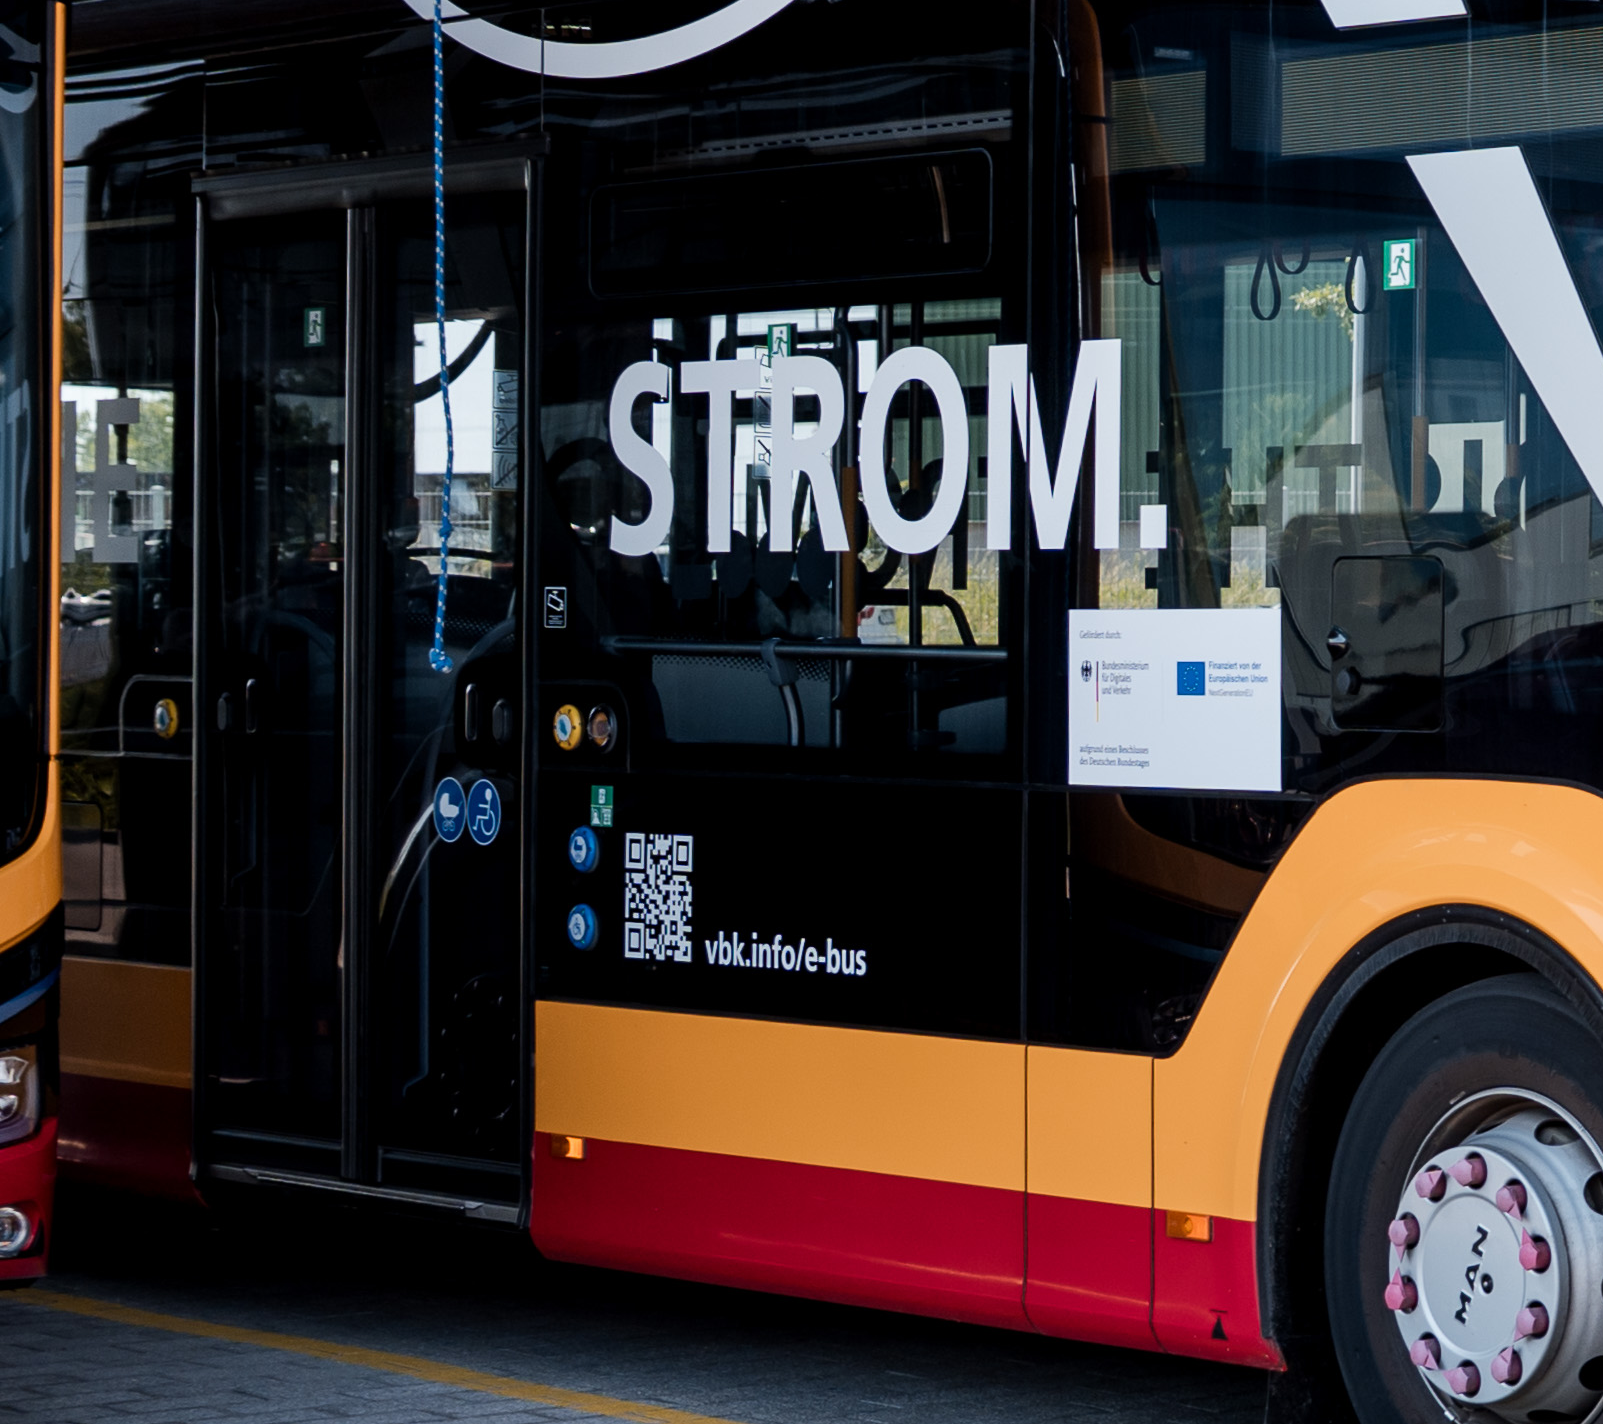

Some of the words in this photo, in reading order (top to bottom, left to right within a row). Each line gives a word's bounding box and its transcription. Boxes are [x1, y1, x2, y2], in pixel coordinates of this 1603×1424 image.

[609, 338, 1168, 556] STROM.
[1208, 661, 1237, 670] Finanziert
[1239, 662, 1249, 670] von
[1251, 661, 1261, 670] der
[1250, 674, 1268, 683] Union
[705, 932, 867, 976] vbk.info/e-bus
[1454, 1223, 1490, 1325] MAN
